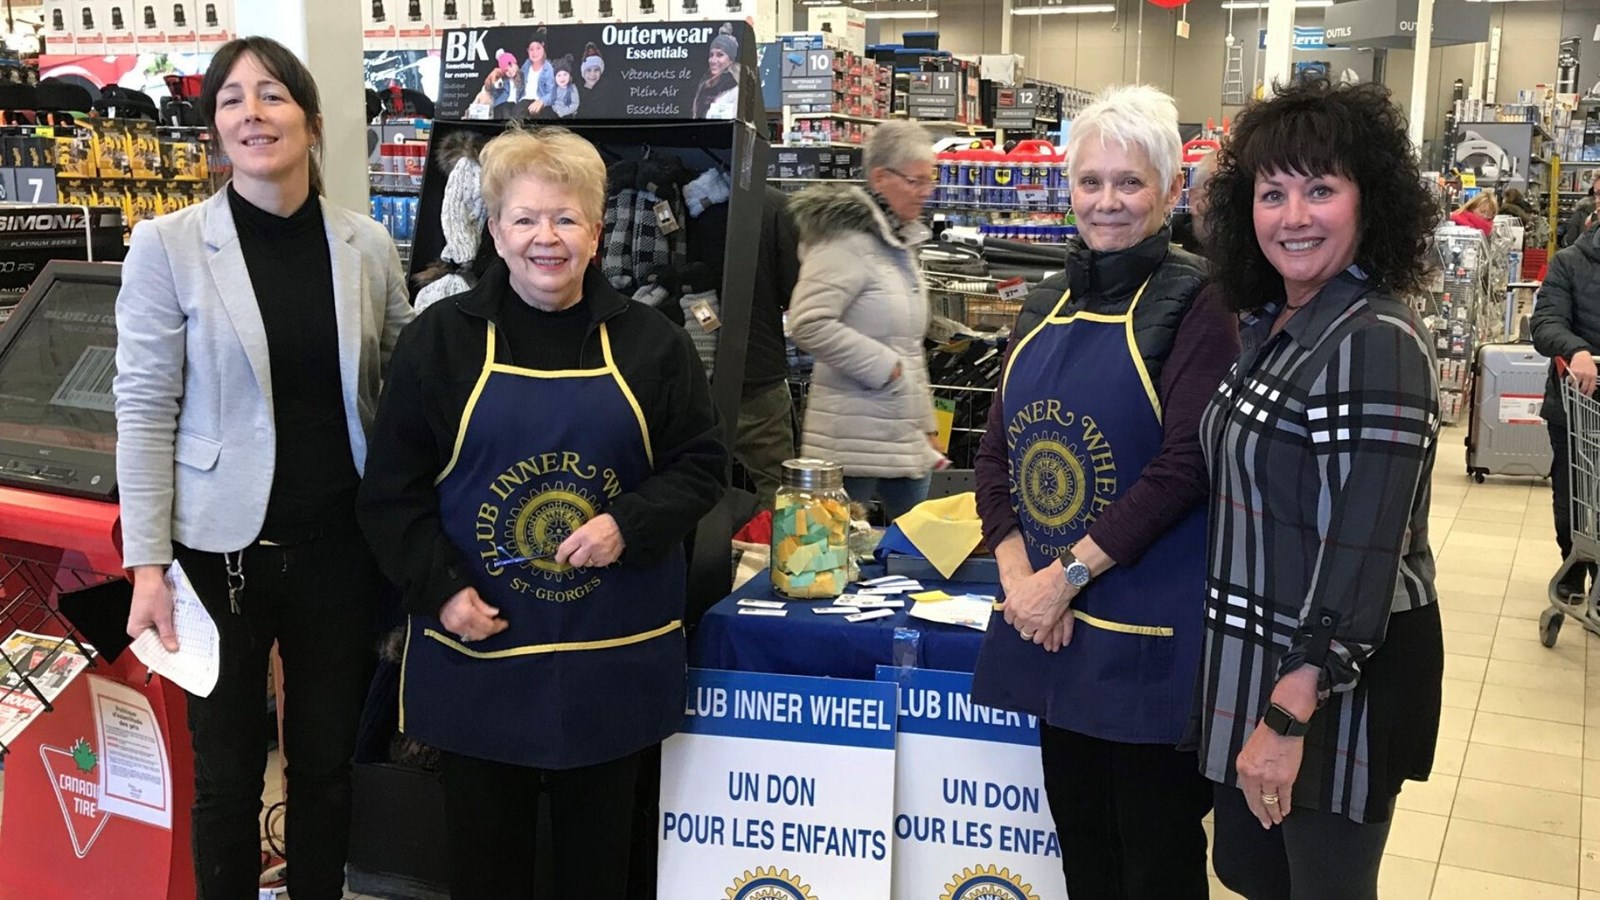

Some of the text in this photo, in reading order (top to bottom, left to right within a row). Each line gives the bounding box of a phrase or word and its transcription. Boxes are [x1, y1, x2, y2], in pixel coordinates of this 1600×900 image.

[602, 25, 713, 45] Outerwear
[1326, 26, 1352, 38] OUTILS
[446, 30, 489, 61] BK
[626, 46, 688, 59] Essentials
[621, 67, 692, 80] Vêtements de
[810, 54, 829, 70] 10
[630, 85, 680, 97] Plein Air
[938, 76, 949, 89] 11
[626, 102, 680, 114] Essentiels
[1020, 92, 1033, 104] 12
[28, 178, 43, 204] 7
[87, 313, 100, 323] LE
[101, 315, 115, 324] CO
[489, 451, 597, 501] INNER
[542, 509, 575, 523] INNER
[476, 502, 504, 577] CLUB
[510, 576, 602, 602] ST-GEORGES
[684, 686, 892, 731] LUB INNER WHEEL
[898, 687, 942, 719] LUB
[59, 773, 98, 798] CANADI
[728, 771, 815, 807] UN DON
[942, 777, 1040, 814] UN DON
[73, 797, 95, 818] TIRE
[663, 812, 886, 861] POUR LES ENFANTS
[894, 814, 1061, 858] OUR LES ENFA
